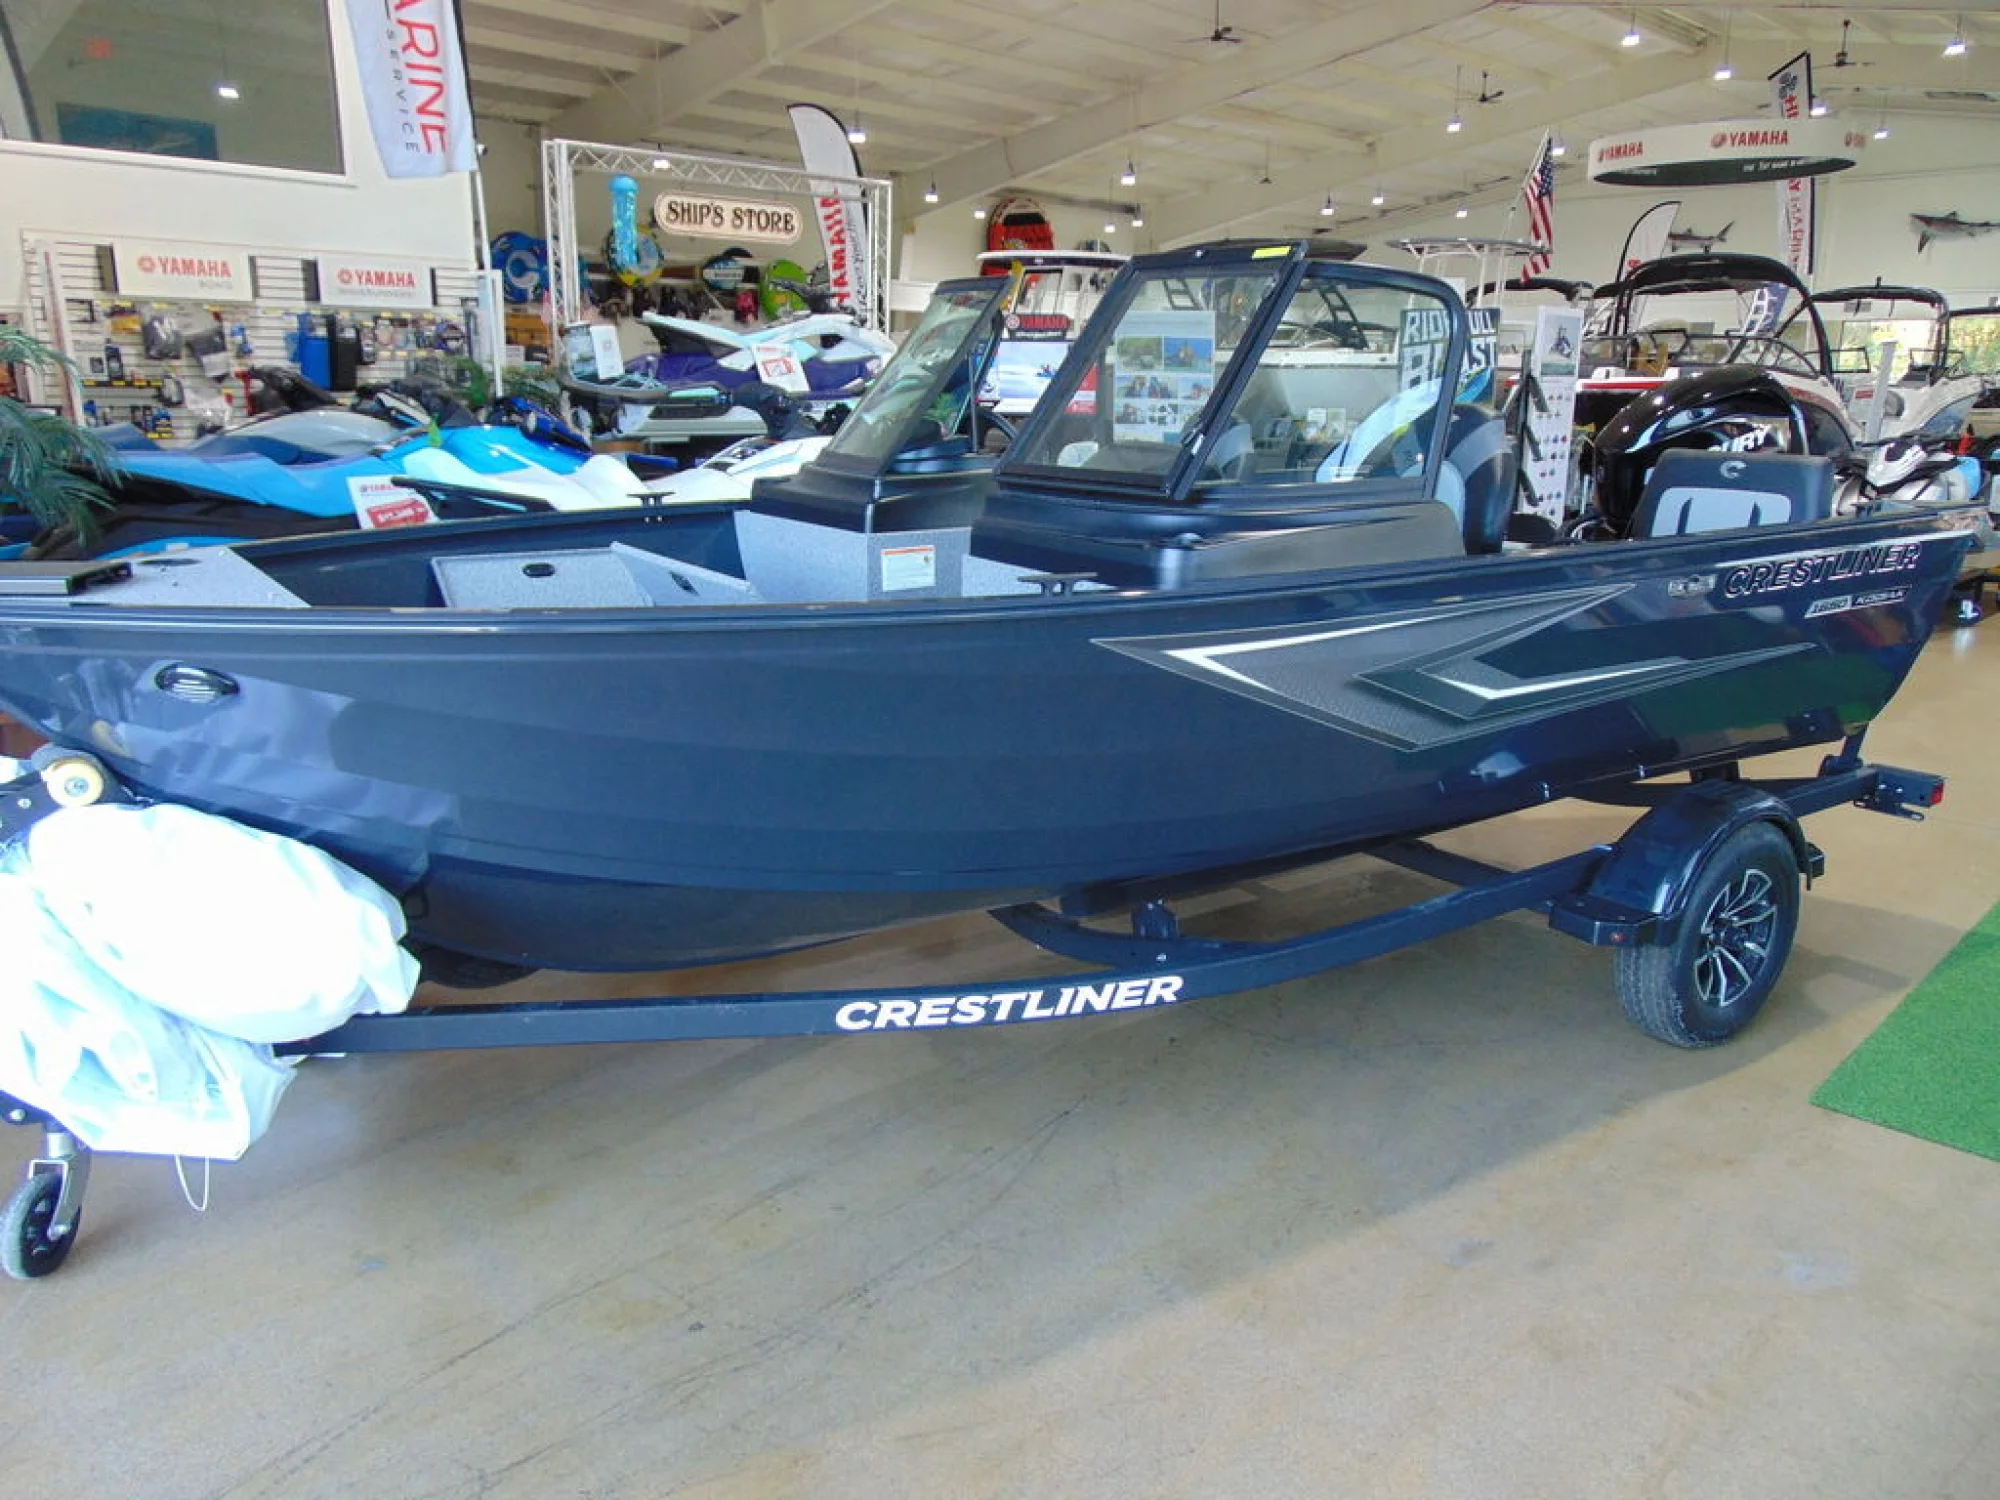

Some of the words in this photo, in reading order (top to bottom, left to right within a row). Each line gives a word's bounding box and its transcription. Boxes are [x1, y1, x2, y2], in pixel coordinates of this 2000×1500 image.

[386, 28, 420, 152] SERVICE
[1728, 129, 1788, 148] YAMAHA
[666, 200, 725, 227] SHIP'S
[731, 206, 796, 234] STORE
[158, 255, 233, 279] YAMAHA
[354, 268, 415, 288] YAMAHA
[1725, 541, 1921, 599] CRESTLINER
[835, 975, 1184, 1030] CRESTLINER
